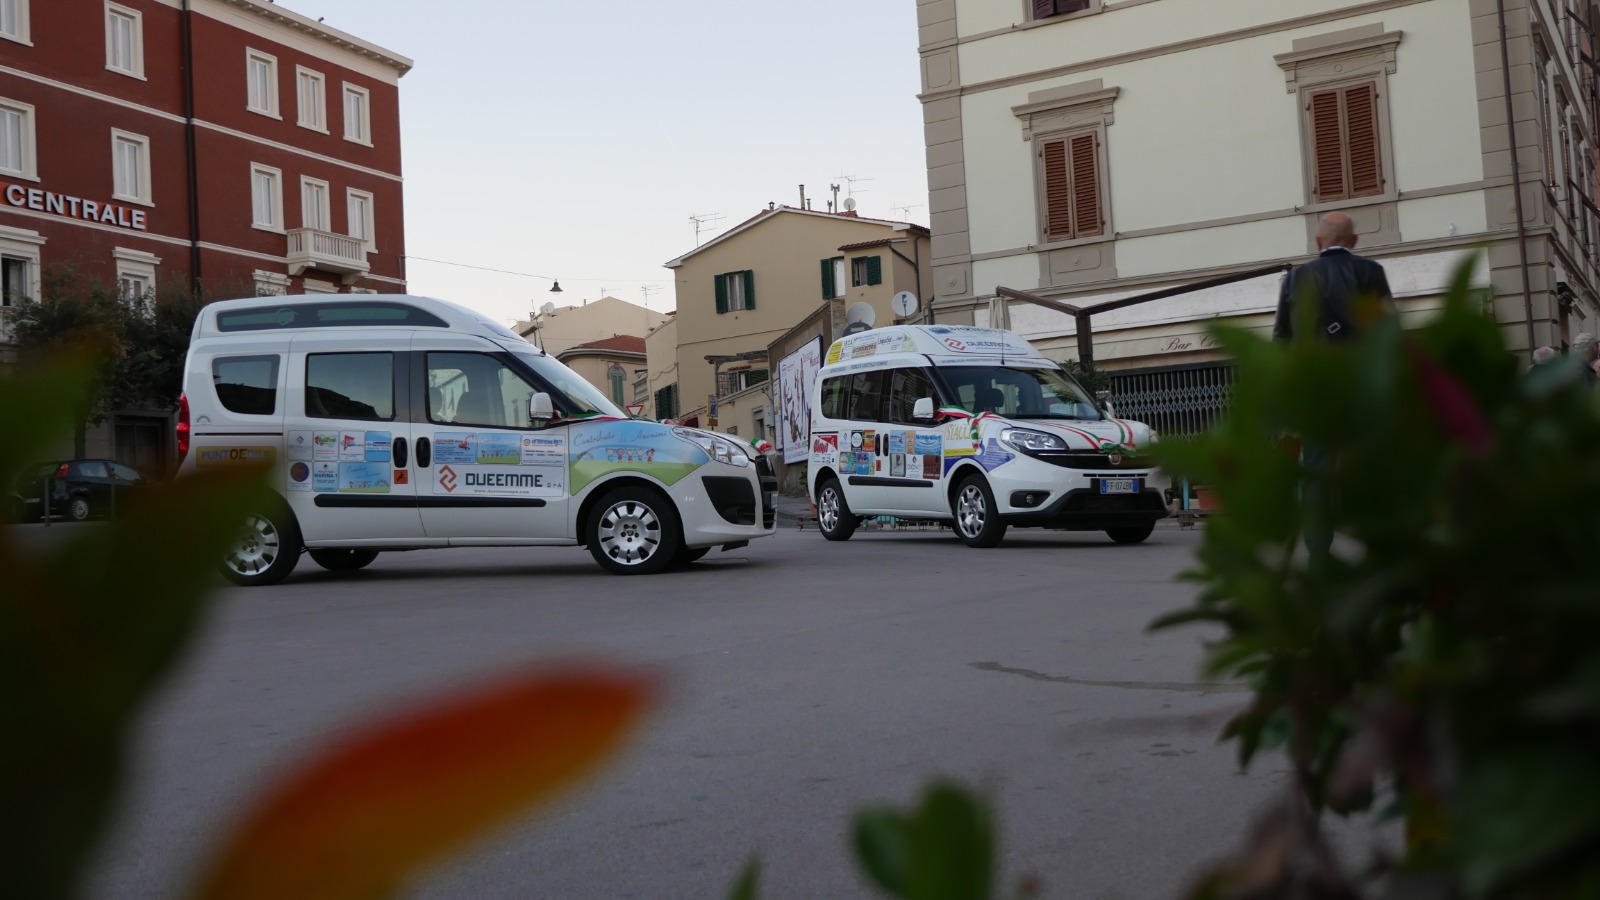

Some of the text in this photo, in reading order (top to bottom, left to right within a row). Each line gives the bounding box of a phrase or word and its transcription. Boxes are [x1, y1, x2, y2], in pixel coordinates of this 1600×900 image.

[6, 184, 147, 230] CENTRALE
[1161, 337, 1192, 351] Bar
[631, 428, 667, 442] Anonimi
[465, 472, 543, 488] DUEEMME
